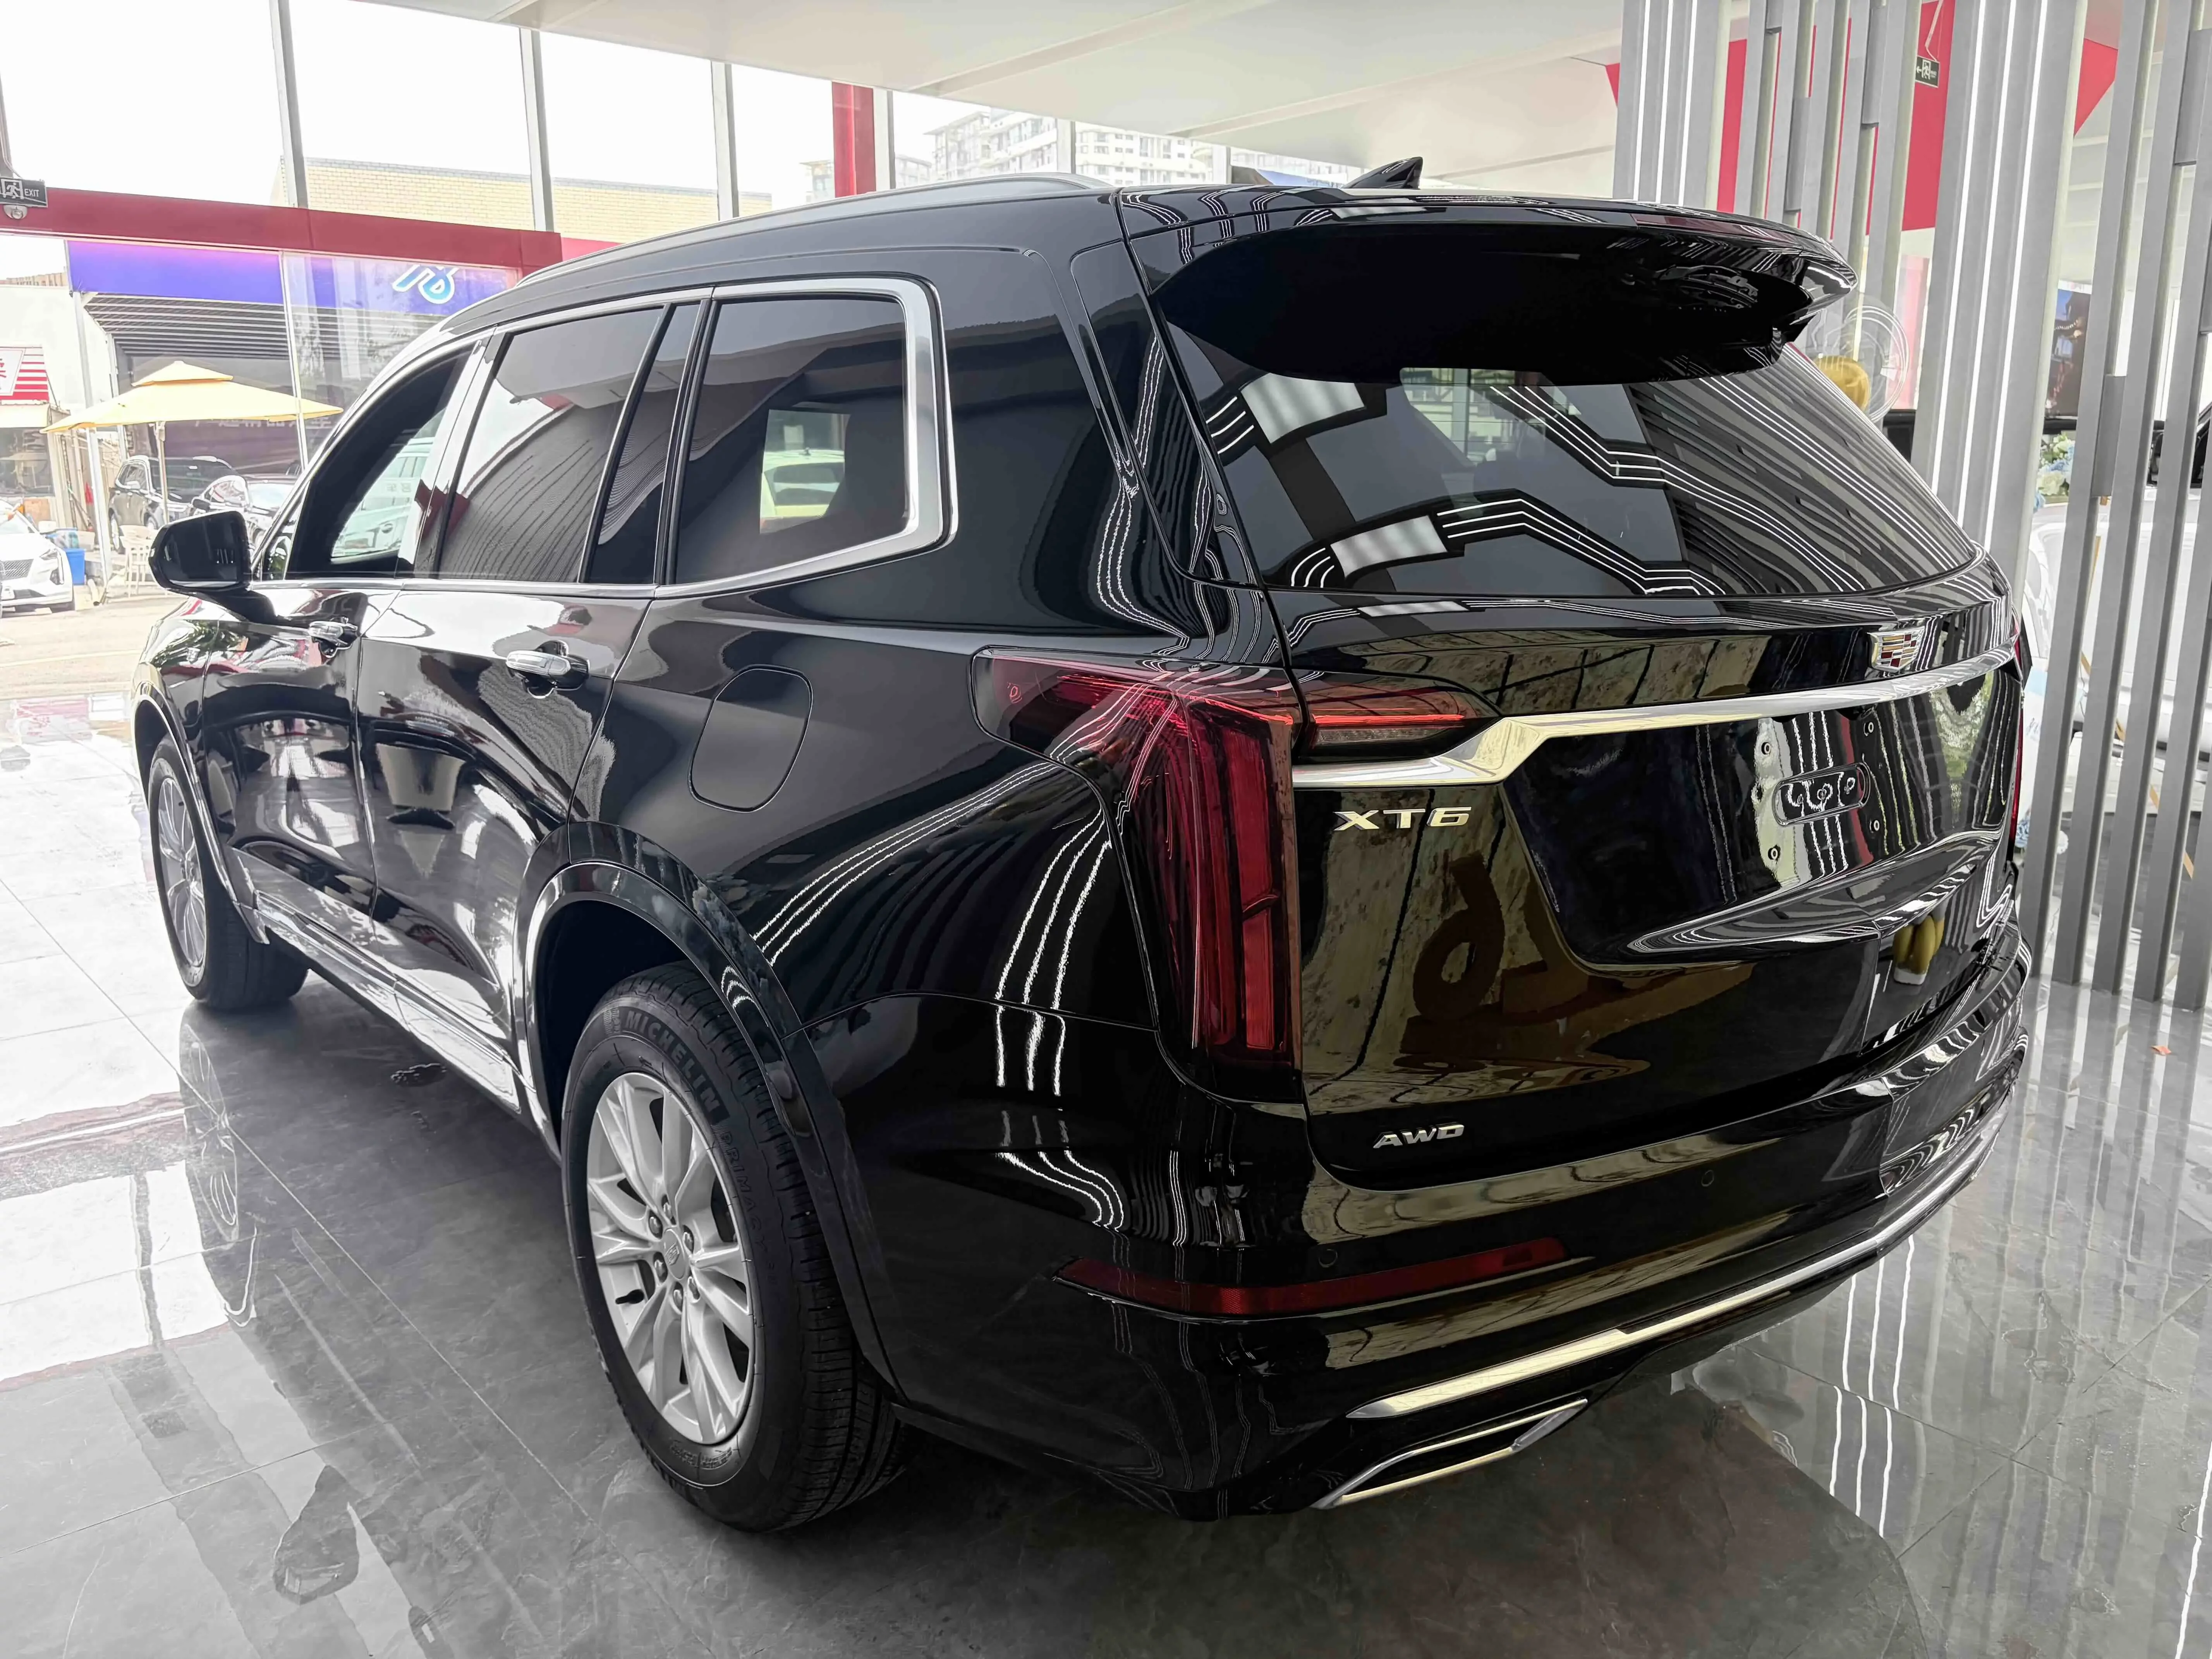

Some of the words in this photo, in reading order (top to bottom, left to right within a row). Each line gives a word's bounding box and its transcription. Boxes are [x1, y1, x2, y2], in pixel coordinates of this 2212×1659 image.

[24, 189, 39, 197] EXIT
[1333, 807, 1472, 831] XT6
[625, 1010, 720, 1113] MICHELIN
[1372, 1124, 1465, 1149] AWD
[720, 1131, 768, 1254] PRIMACY
